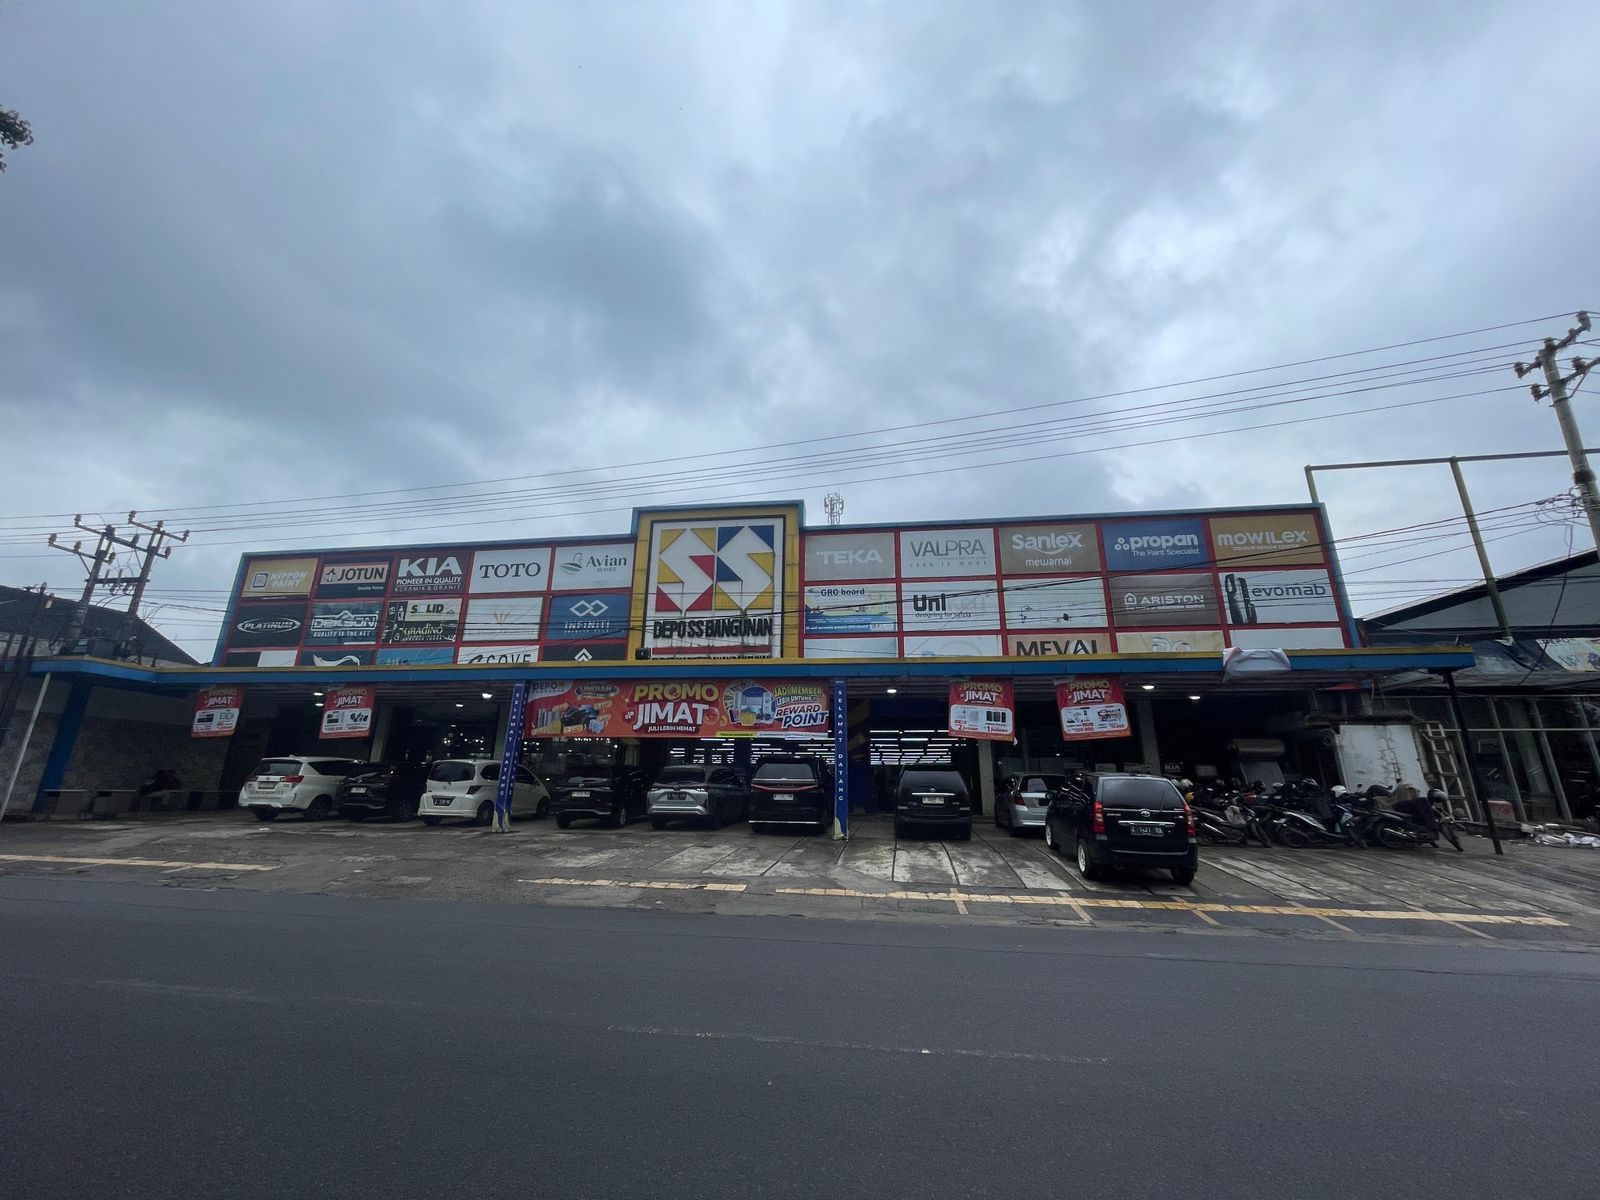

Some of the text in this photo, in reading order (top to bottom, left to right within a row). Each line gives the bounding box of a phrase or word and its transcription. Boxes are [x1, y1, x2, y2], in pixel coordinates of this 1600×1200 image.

[1012, 531, 1083, 550] Sanlex
[1129, 534, 1199, 550] propan
[910, 539, 986, 557] VALPRA
[1166, 548, 1200, 556] Specialist
[586, 555, 627, 568] Avian
[821, 550, 883, 565] TEKA
[1025, 556, 1072, 568] mewarnai
[398, 556, 462, 578] KIA
[479, 562, 542, 578] TOTO
[338, 568, 385, 582] JOTUN
[396, 578, 424, 586] PIONEER
[434, 576, 462, 584] QUALITY
[1252, 584, 1326, 597] evomab
[1140, 594, 1204, 605] ARISTON
[411, 604, 444, 614] SLID
[653, 618, 772, 638] DEPO SS BANGUNAN
[962, 682, 1002, 692] PROMO
[1070, 680, 1110, 690] PROMO
[634, 682, 720, 702] PROMO
[964, 690, 998, 702] JIMAT
[1073, 688, 1106, 703] JIMAT
[206, 696, 233, 707] JIMAT
[336, 696, 363, 707] JIMAT
[633, 702, 710, 730] JIMAT
[776, 704, 820, 717] REWARD
[783, 712, 828, 728] POINT
